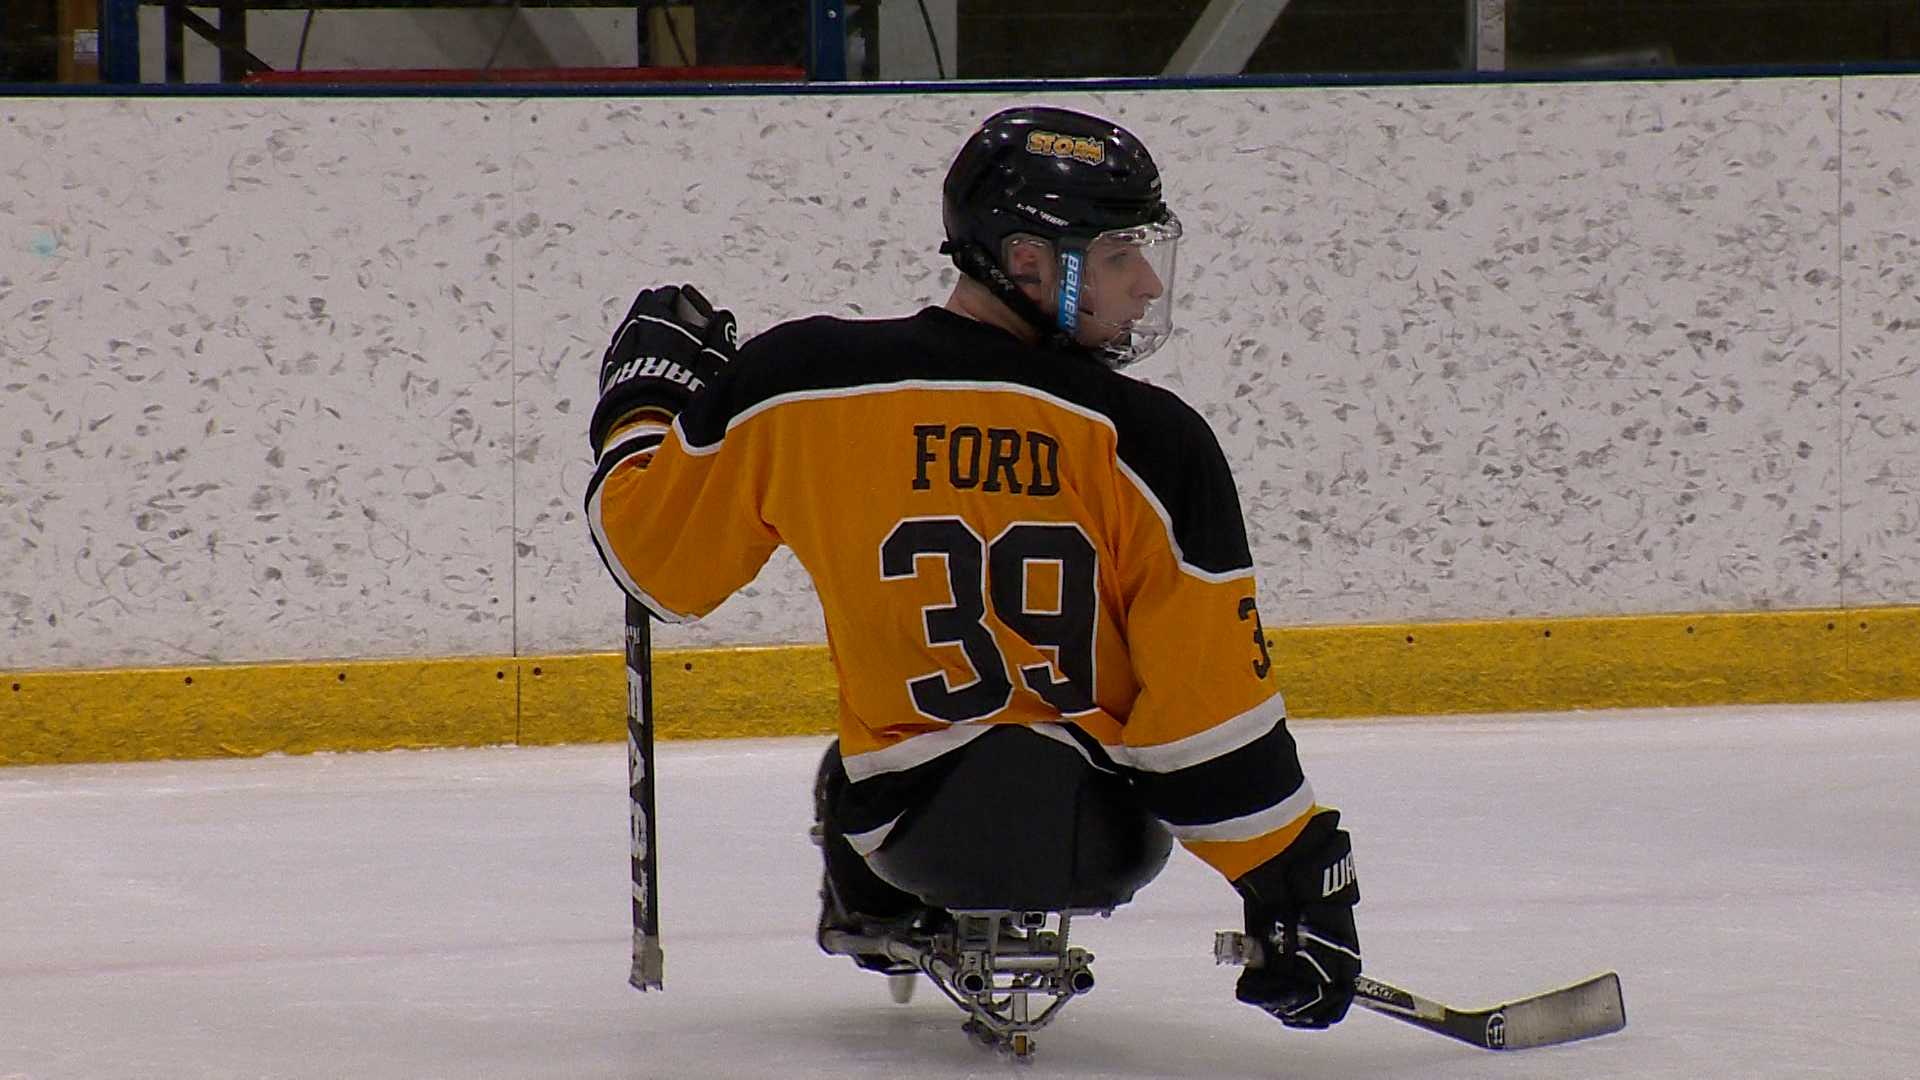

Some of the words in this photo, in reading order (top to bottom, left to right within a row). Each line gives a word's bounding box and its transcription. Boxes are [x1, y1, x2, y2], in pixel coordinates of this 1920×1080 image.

[1027, 131, 1104, 165] STORM
[912, 424, 1060, 496] FORD
[879, 515, 1100, 723] 39
